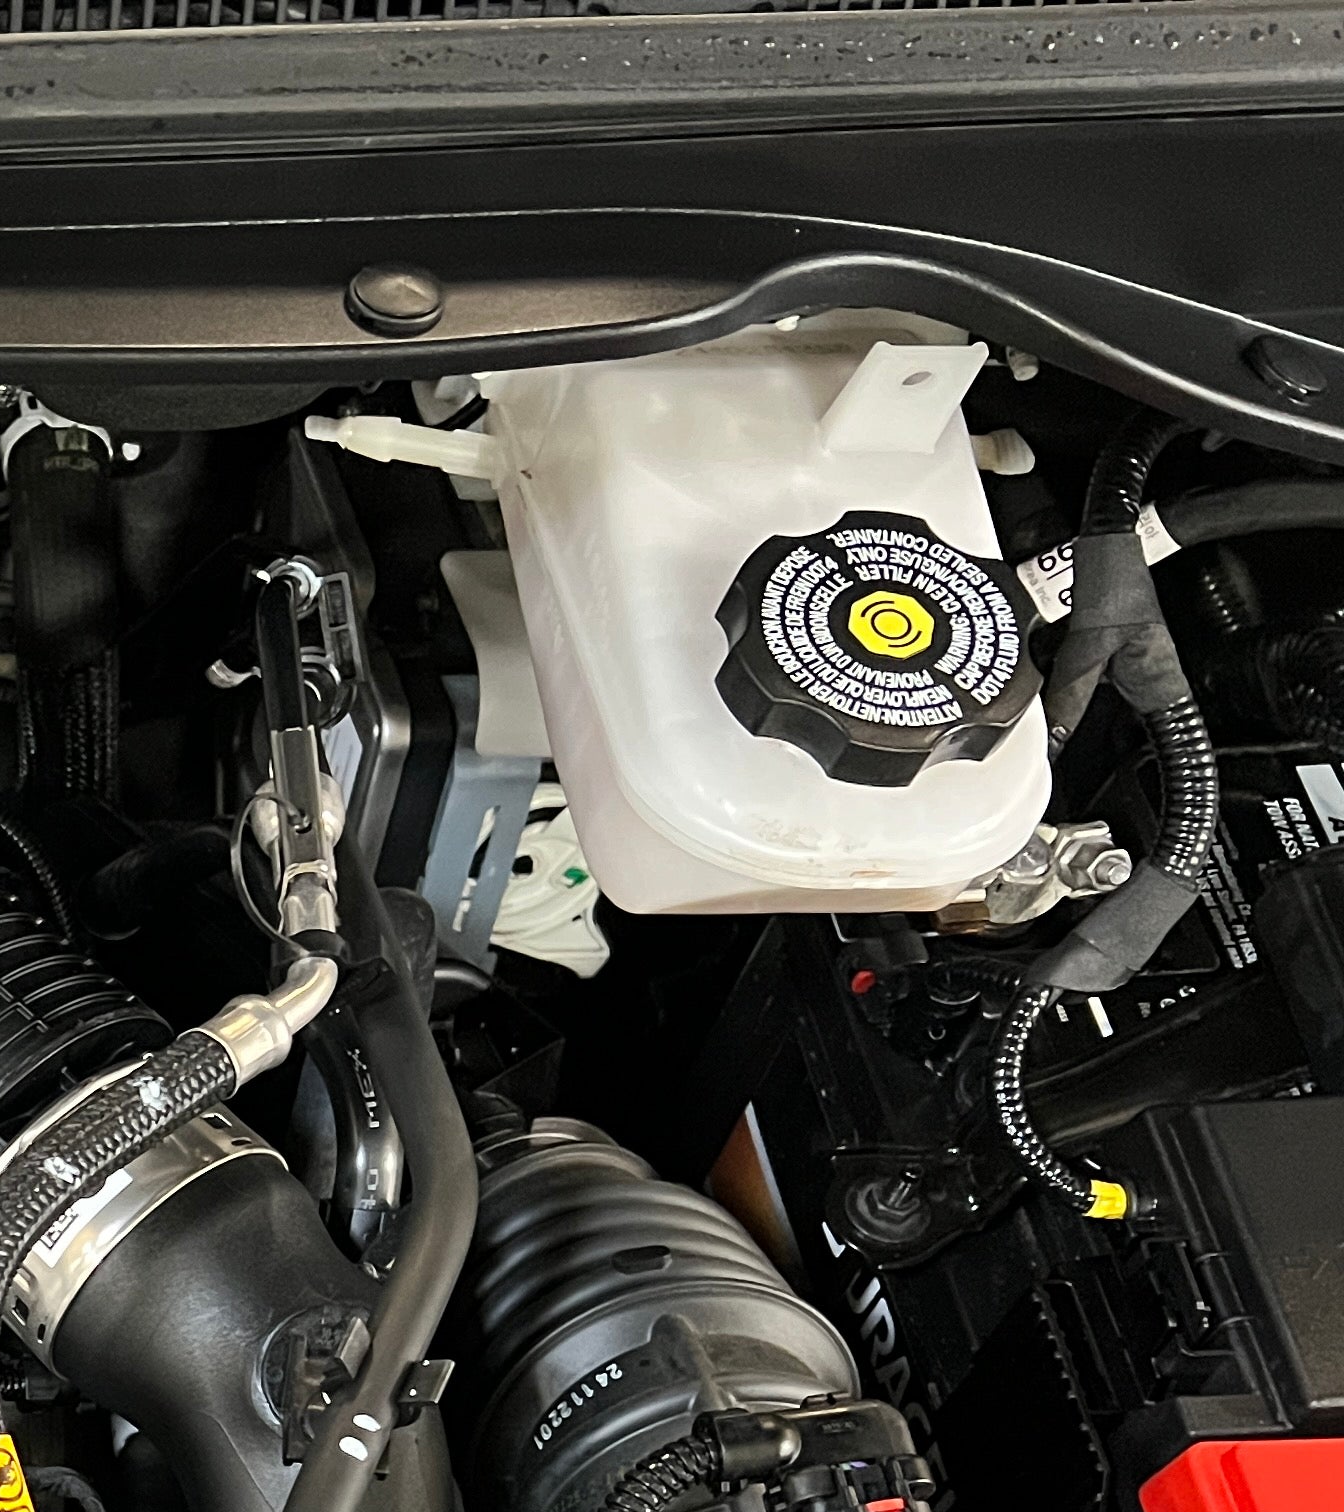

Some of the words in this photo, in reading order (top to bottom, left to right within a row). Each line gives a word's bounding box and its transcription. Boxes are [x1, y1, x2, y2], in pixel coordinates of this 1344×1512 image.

[826, 529, 928, 551] CONTAINER.
[825, 556, 839, 570] 4
[846, 547, 887, 564] ONLY
[929, 544, 988, 586] SEALED
[805, 560, 829, 585] DOT
[855, 565, 912, 583] FILLER
[762, 586, 782, 619] AVANT
[786, 578, 815, 608] FREIN
[913, 574, 961, 614] CLEAN
[982, 582, 996, 596] A
[785, 606, 805, 625] DE
[809, 612, 829, 642] BIDON
[989, 595, 1018, 632] FROM
[763, 619, 798, 672] BOUCHON
[786, 625, 819, 667] LIQUIDE
[934, 614, 971, 674] WARNING:
[974, 615, 995, 665] BEFORE
[999, 634, 1019, 671] FLUID
[790, 664, 811, 687] LE
[816, 661, 838, 682] DU
[837, 673, 865, 697] QUE
[845, 662, 934, 687] PROVENANT
[954, 664, 979, 690] CAP
[807, 683, 883, 724] NETTOYER
[971, 674, 1000, 705] DOT
[1283, 798, 1307, 821] FOR
[346, 1048, 380, 1129] MEX
[533, 1362, 623, 1451] 24112201
